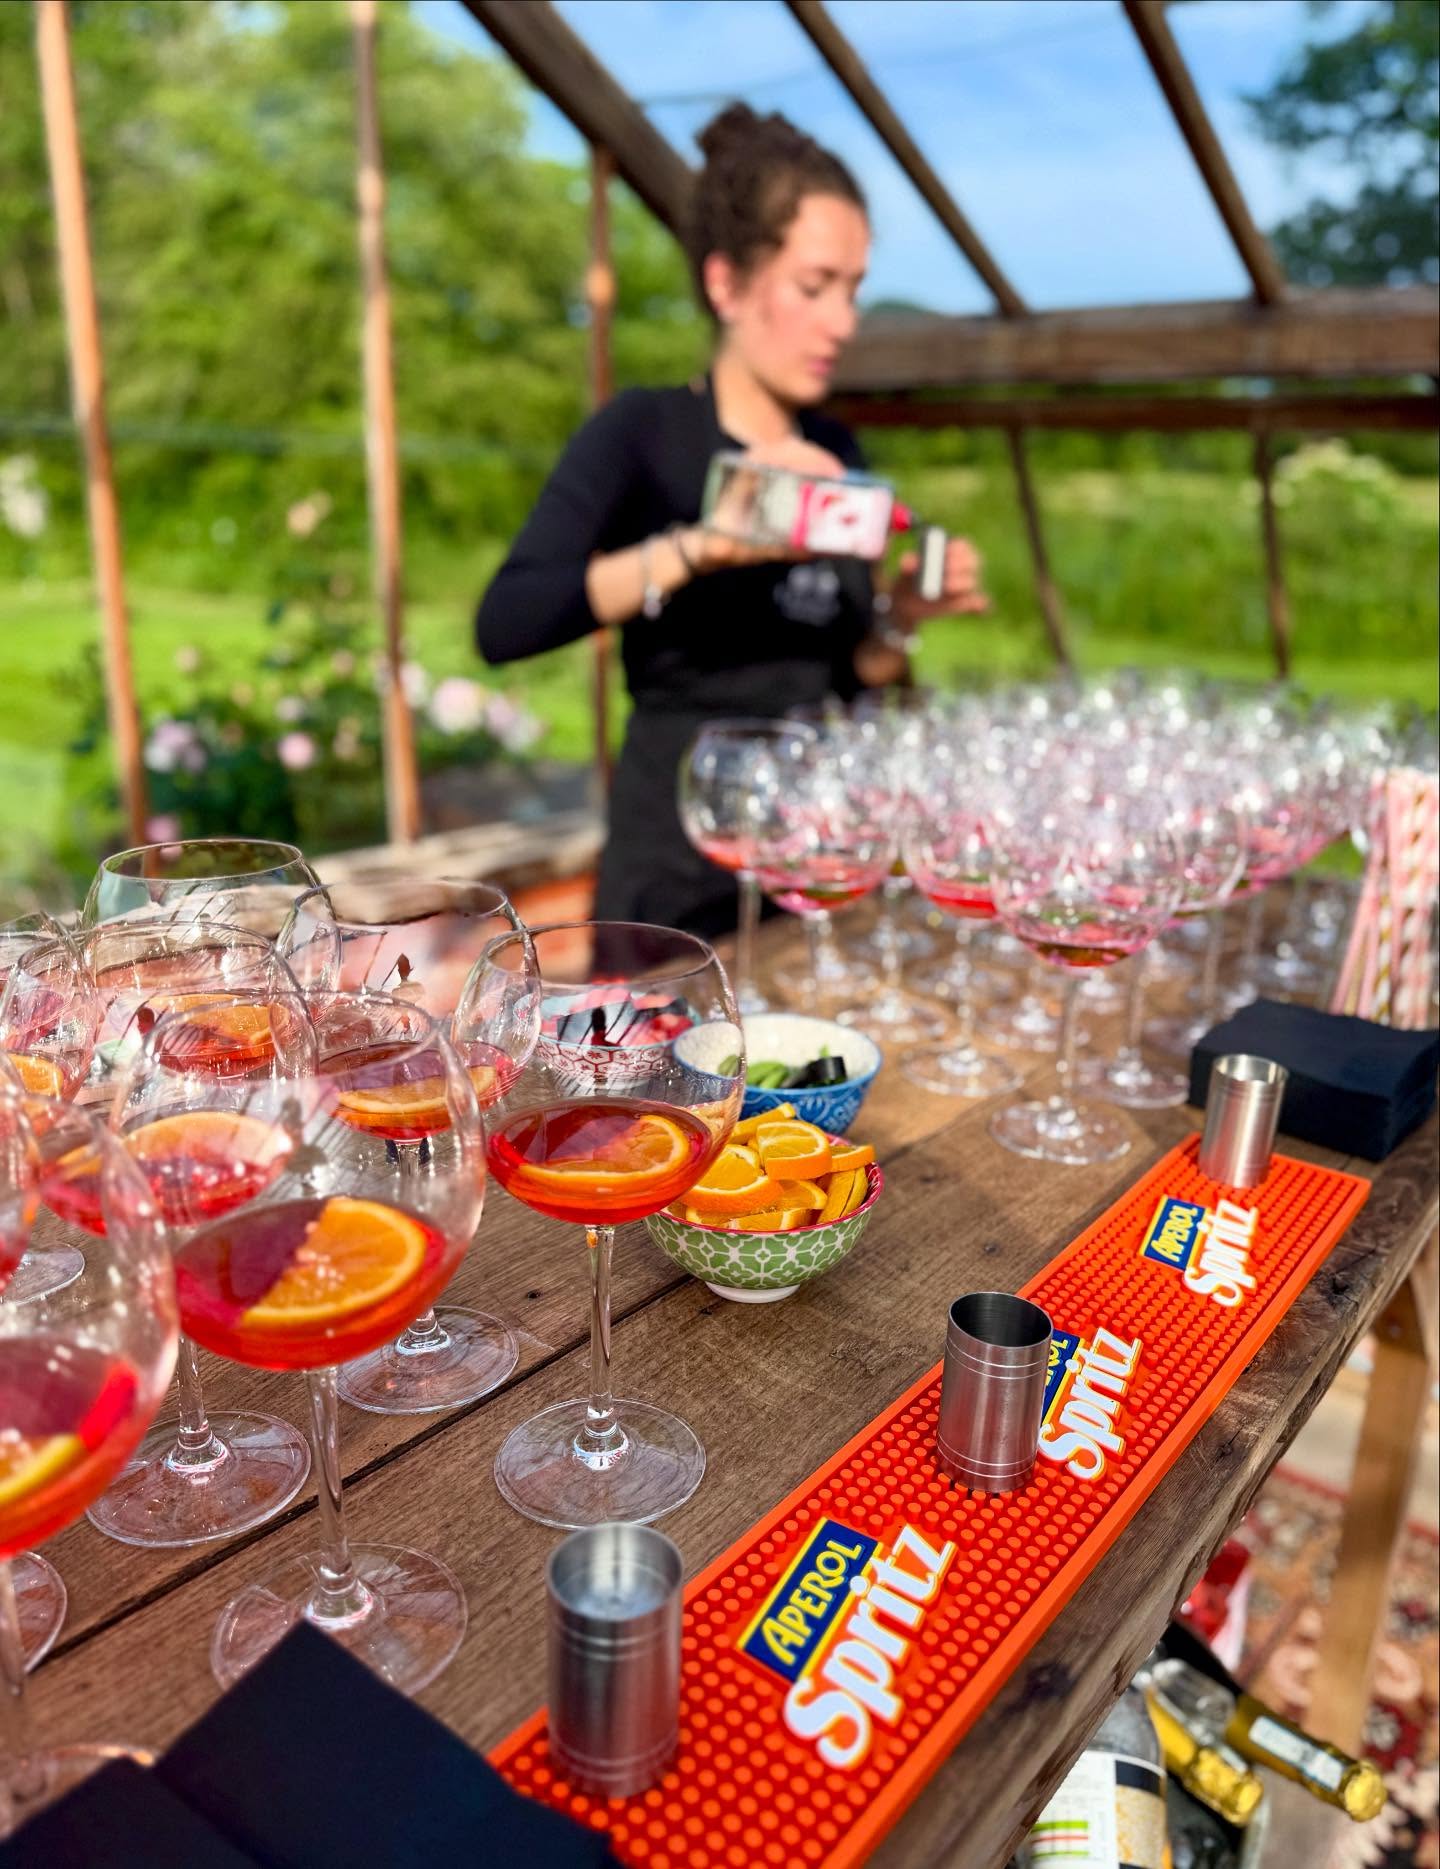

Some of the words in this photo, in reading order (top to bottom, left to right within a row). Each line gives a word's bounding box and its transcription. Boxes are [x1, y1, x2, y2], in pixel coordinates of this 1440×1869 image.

[1150, 1204, 1199, 1263] APEROL
[1183, 1199, 1259, 1308] Spritz
[1038, 1326, 1144, 1480] Spritz
[761, 1539, 864, 1667] APEROL
[783, 1523, 957, 1769] Spritz
